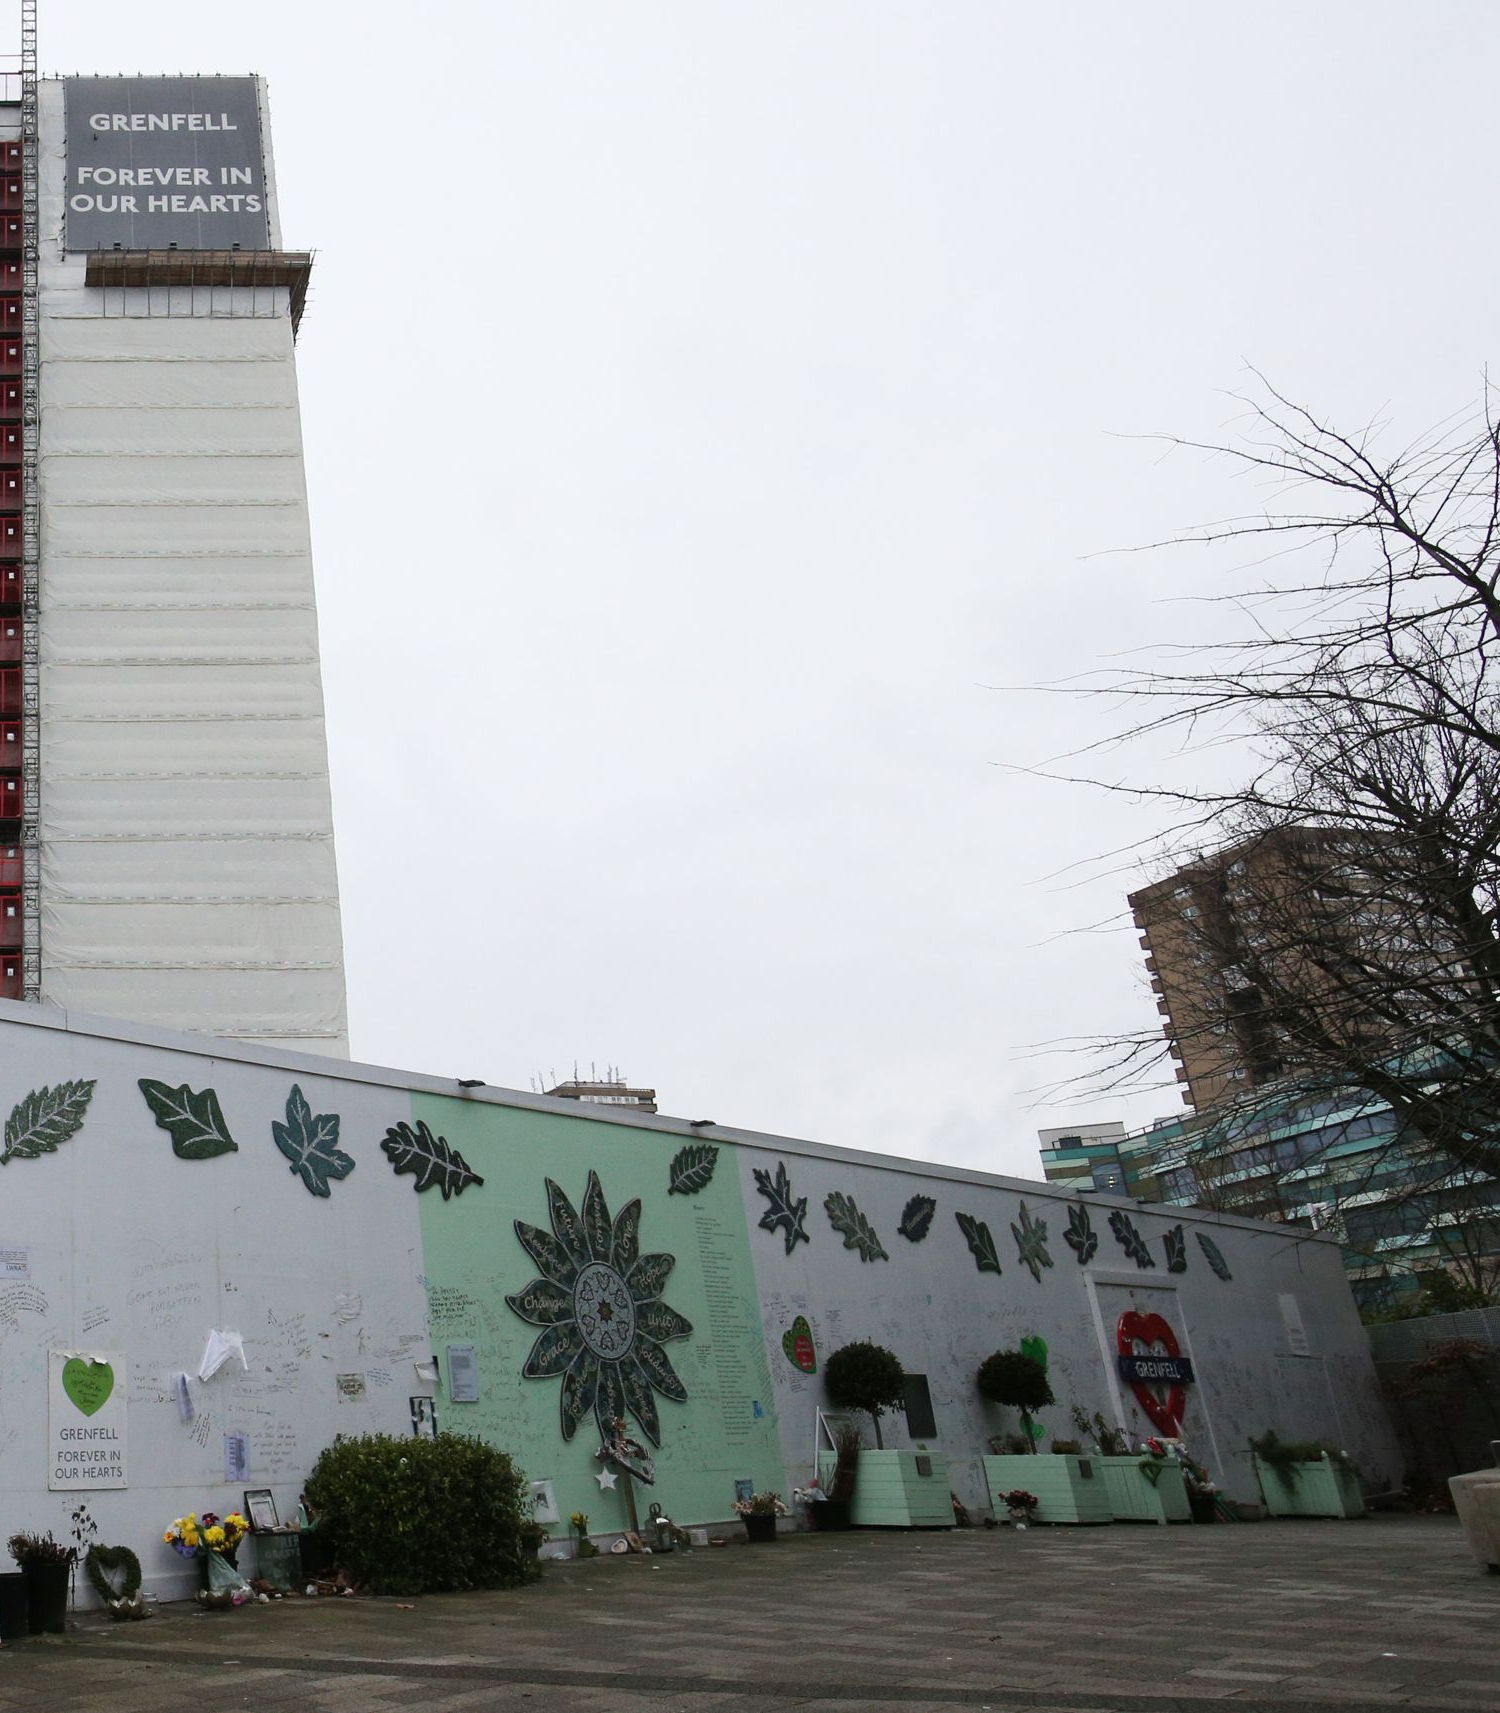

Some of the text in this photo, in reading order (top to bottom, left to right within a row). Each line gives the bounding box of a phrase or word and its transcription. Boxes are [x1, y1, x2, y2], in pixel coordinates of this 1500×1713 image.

[89, 113, 238, 131] GRENFELL
[78, 167, 253, 186] FOREVER IN
[70, 194, 262, 213] OUR HEARTS
[555, 1201, 581, 1250] Future
[618, 1219, 635, 1258] Love
[639, 1268, 661, 1289] Hope
[524, 1296, 565, 1313] Change
[647, 1313, 677, 1332] Unity
[539, 1337, 569, 1366] Grace
[1135, 1361, 1180, 1379] GRENFELL
[60, 1428, 119, 1441] GRENFELL
[58, 1450, 121, 1463] FOREVER IN
[55, 1466, 123, 1479] OUR HEARTS
